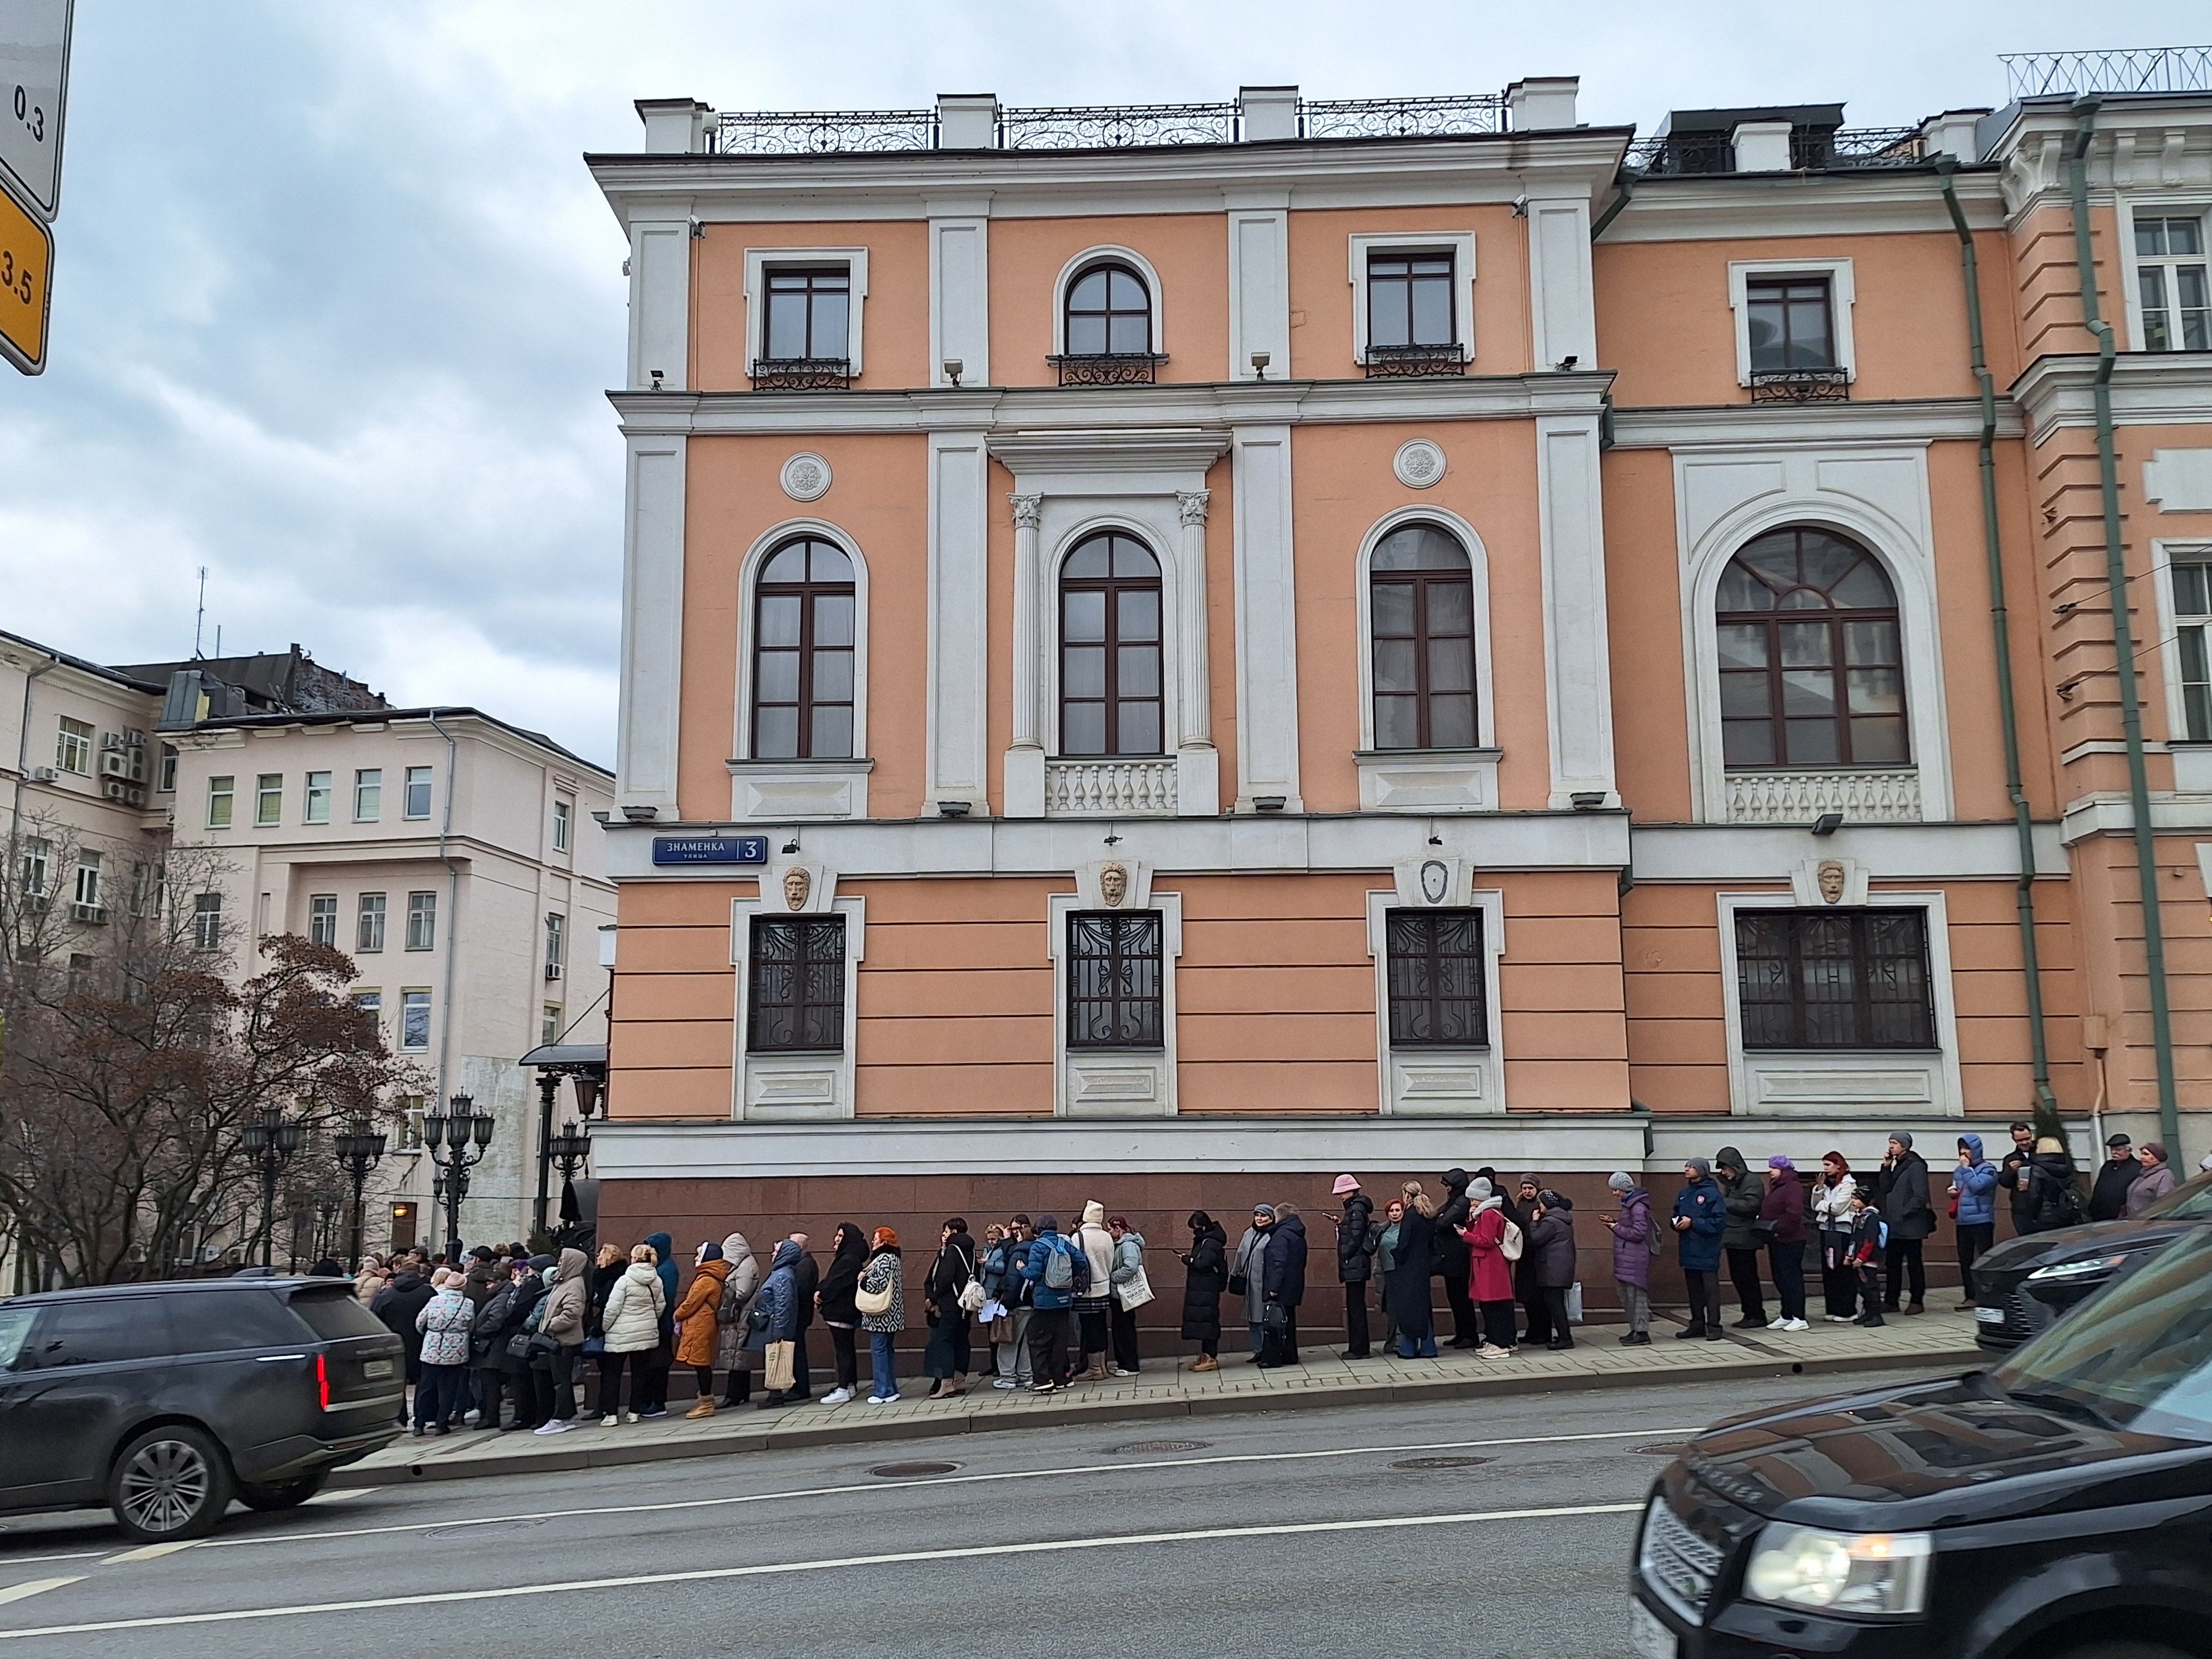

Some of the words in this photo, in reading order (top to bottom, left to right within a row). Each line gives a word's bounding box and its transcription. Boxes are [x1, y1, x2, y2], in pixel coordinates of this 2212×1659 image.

[14, 85, 44, 142] 0.3
[1, 250, 33, 305] 3.5
[666, 841, 725, 852] ЗНАМЕНКА
[744, 841, 757, 858] 3
